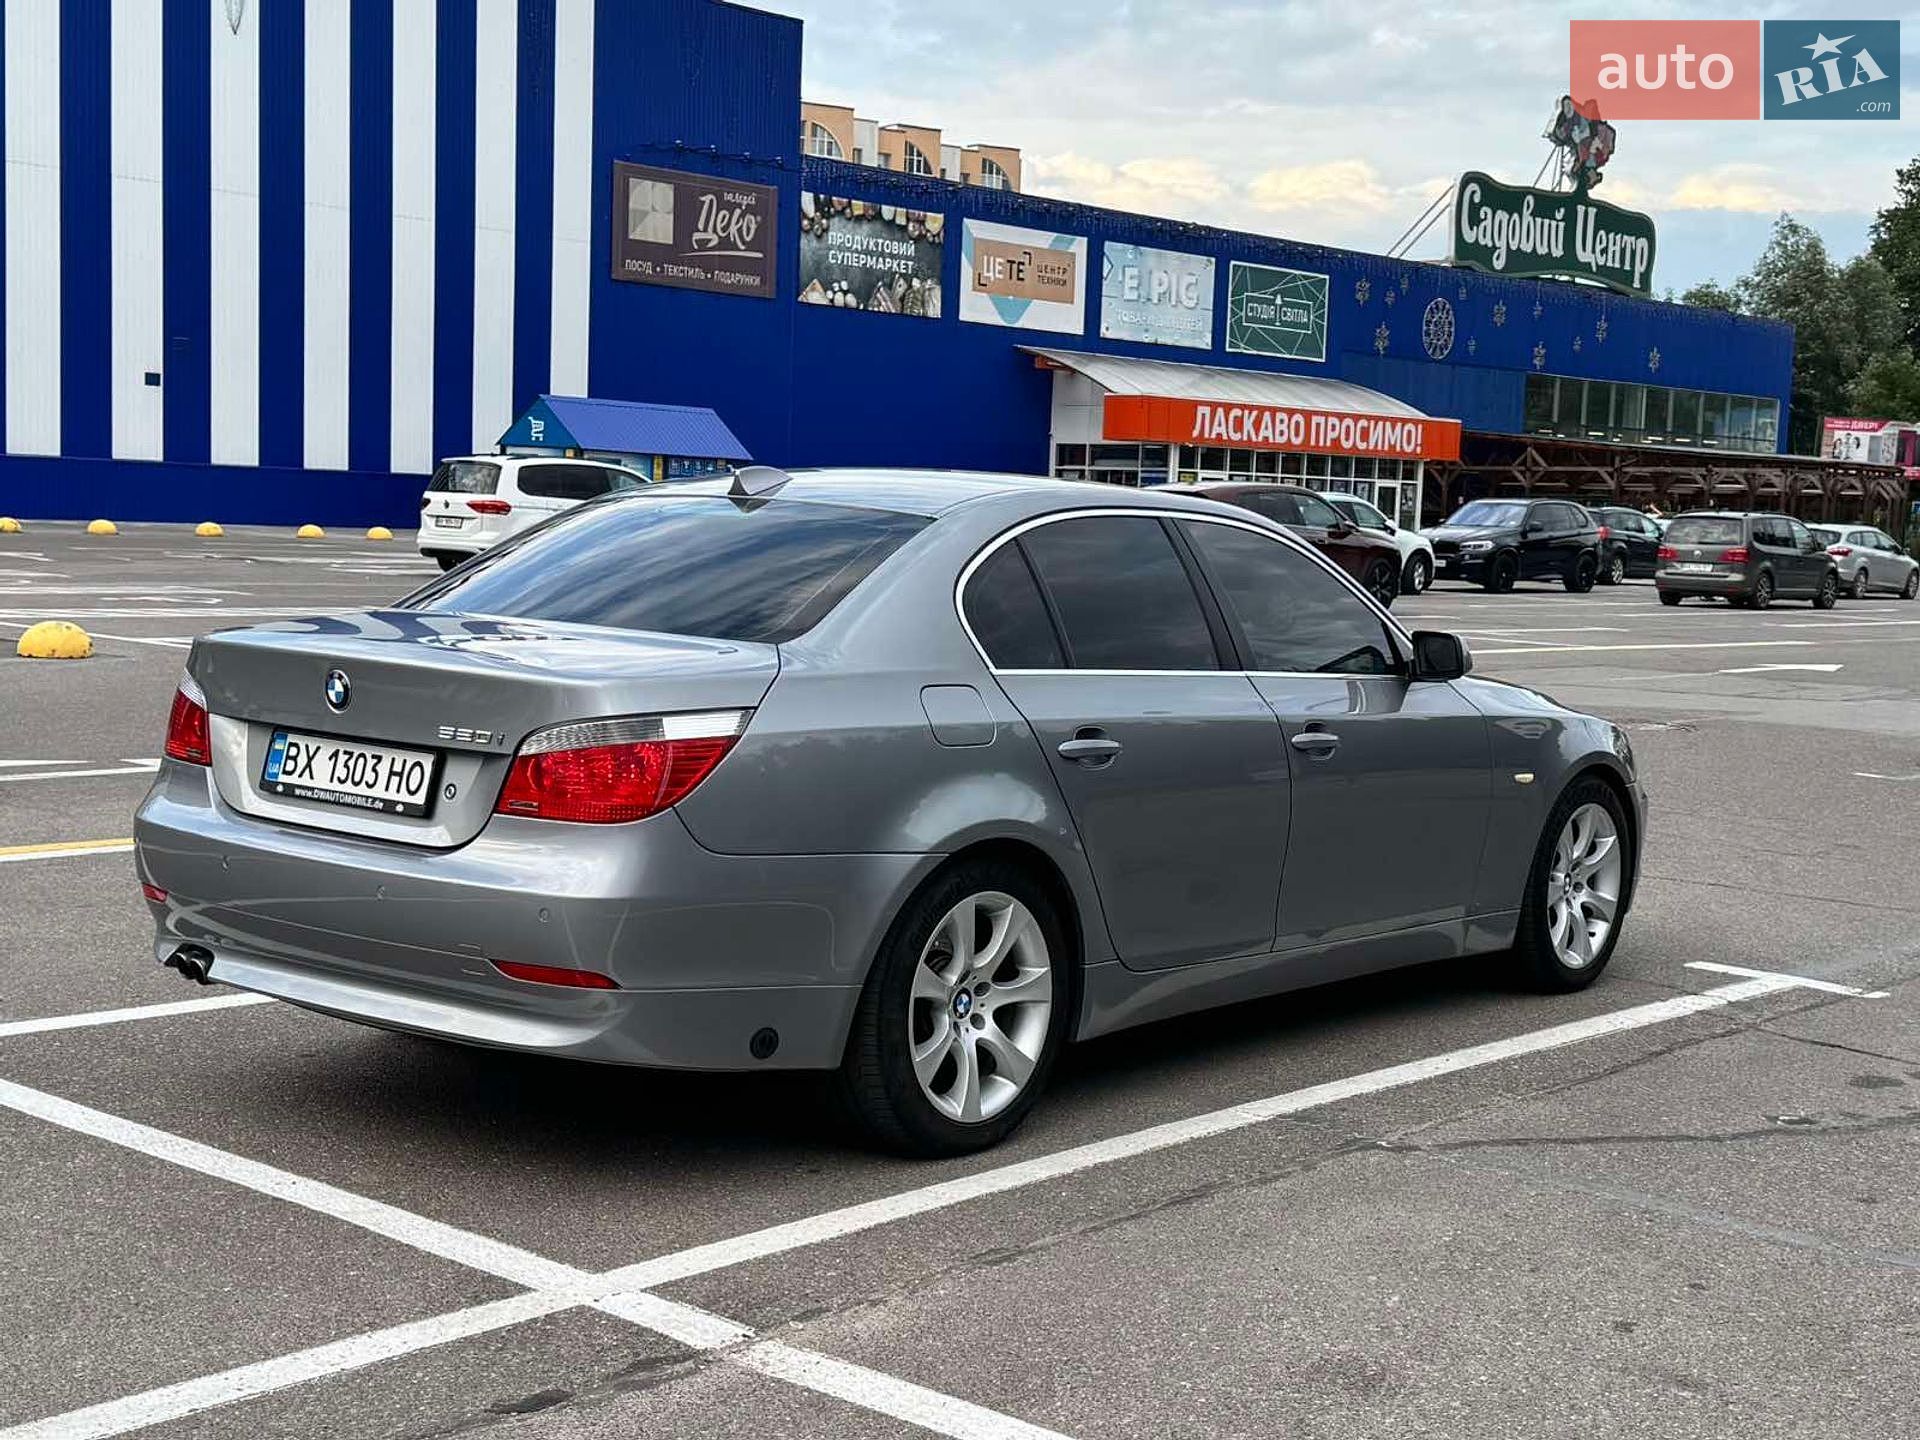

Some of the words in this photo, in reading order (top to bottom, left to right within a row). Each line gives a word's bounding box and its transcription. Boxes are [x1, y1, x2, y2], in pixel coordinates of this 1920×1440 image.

[692, 194, 757, 250] Деко
[828, 231, 915, 256] ПРОДУКТОВИЙ
[1460, 184, 1566, 270] Садовий
[1576, 205, 1649, 289] Центр
[625, 259, 653, 275] ПОСУД
[663, 263, 705, 280] ТЕКСТИЛЬ
[713, 270, 761, 286] ПОДАРУНКИ
[828, 250, 915, 274] СУПЕРМАРКЕТ
[1037, 263, 1067, 276] ЦЕНТР
[1247, 303, 1275, 318] СТУДІЯ
[1281, 307, 1308, 323] СВІТЛА
[1192, 405, 1305, 446] ЛАСКАВО
[1310, 416, 1423, 454] ПРОСИМО!
[282, 741, 322, 780] BX
[328, 749, 383, 790] 1303
[384, 757, 425, 796] HO
